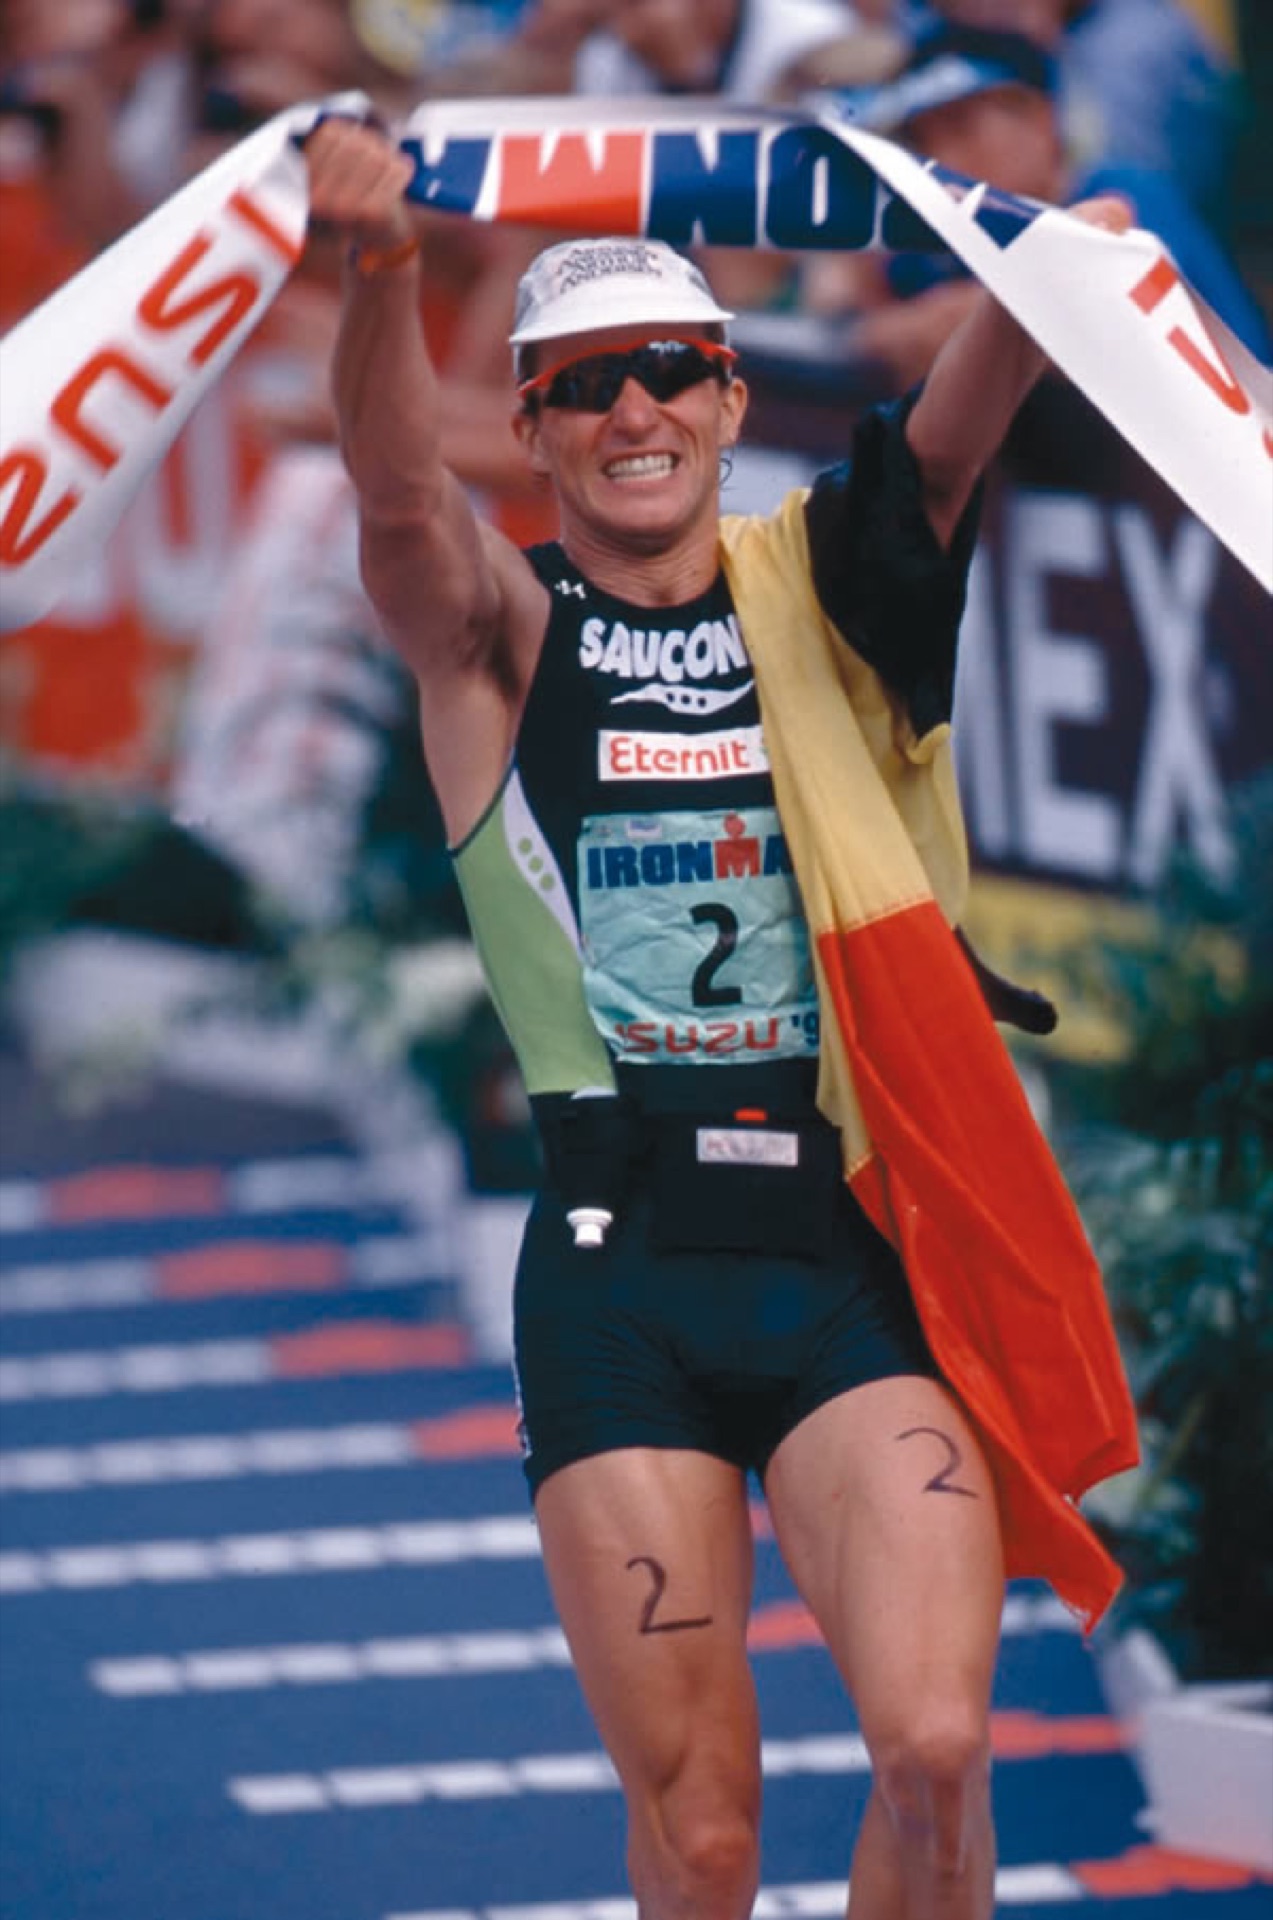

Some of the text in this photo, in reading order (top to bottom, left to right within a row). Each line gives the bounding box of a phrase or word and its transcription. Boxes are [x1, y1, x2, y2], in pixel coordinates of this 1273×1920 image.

[578, 613, 749, 683] SAUCON
[608, 735, 751, 775] Eternit
[688, 901, 743, 1009] 2
[896, 1427, 980, 1500] 2
[626, 1556, 714, 1636] 2
